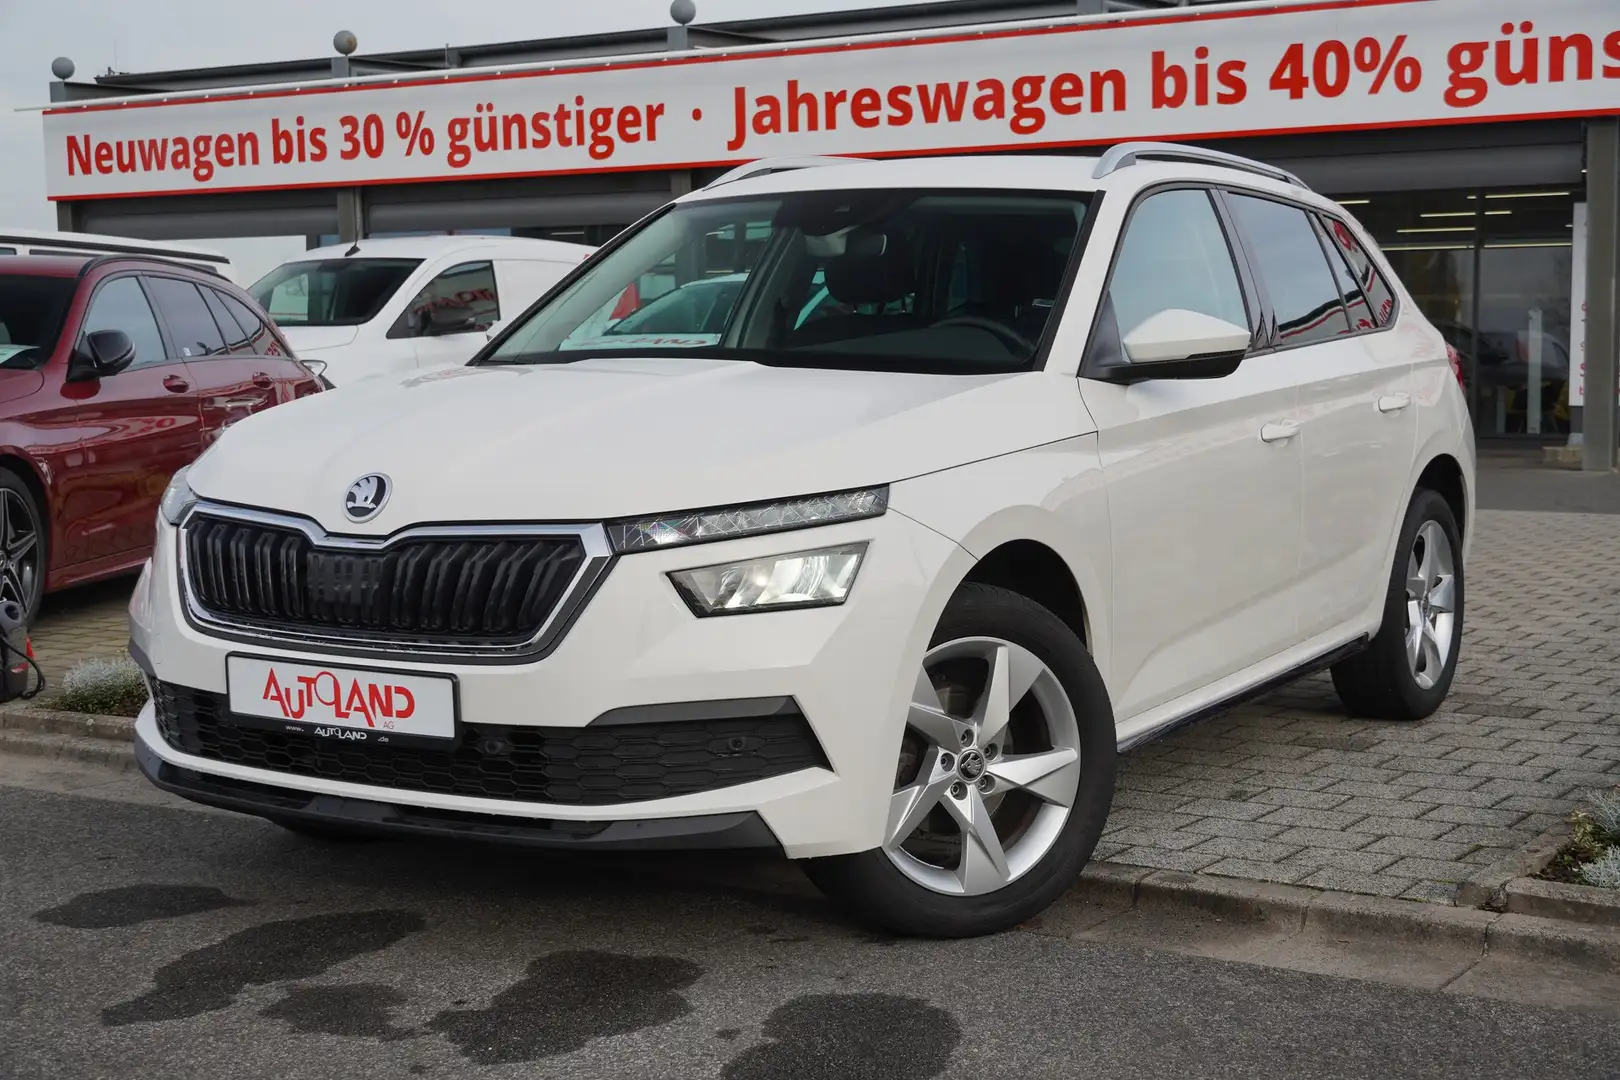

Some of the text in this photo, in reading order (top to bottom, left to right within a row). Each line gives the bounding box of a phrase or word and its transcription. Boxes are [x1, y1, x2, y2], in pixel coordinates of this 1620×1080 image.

[728, 68, 1127, 152] Jahreswagen
[1151, 46, 1247, 109] bis
[1269, 34, 1422, 100] 40%
[67, 96, 665, 182] Neuwagen bis 30 % günstiger
[263, 667, 416, 728] AUTOLAND
[382, 720, 395, 730] AG
[377, 735, 389, 743] .de
